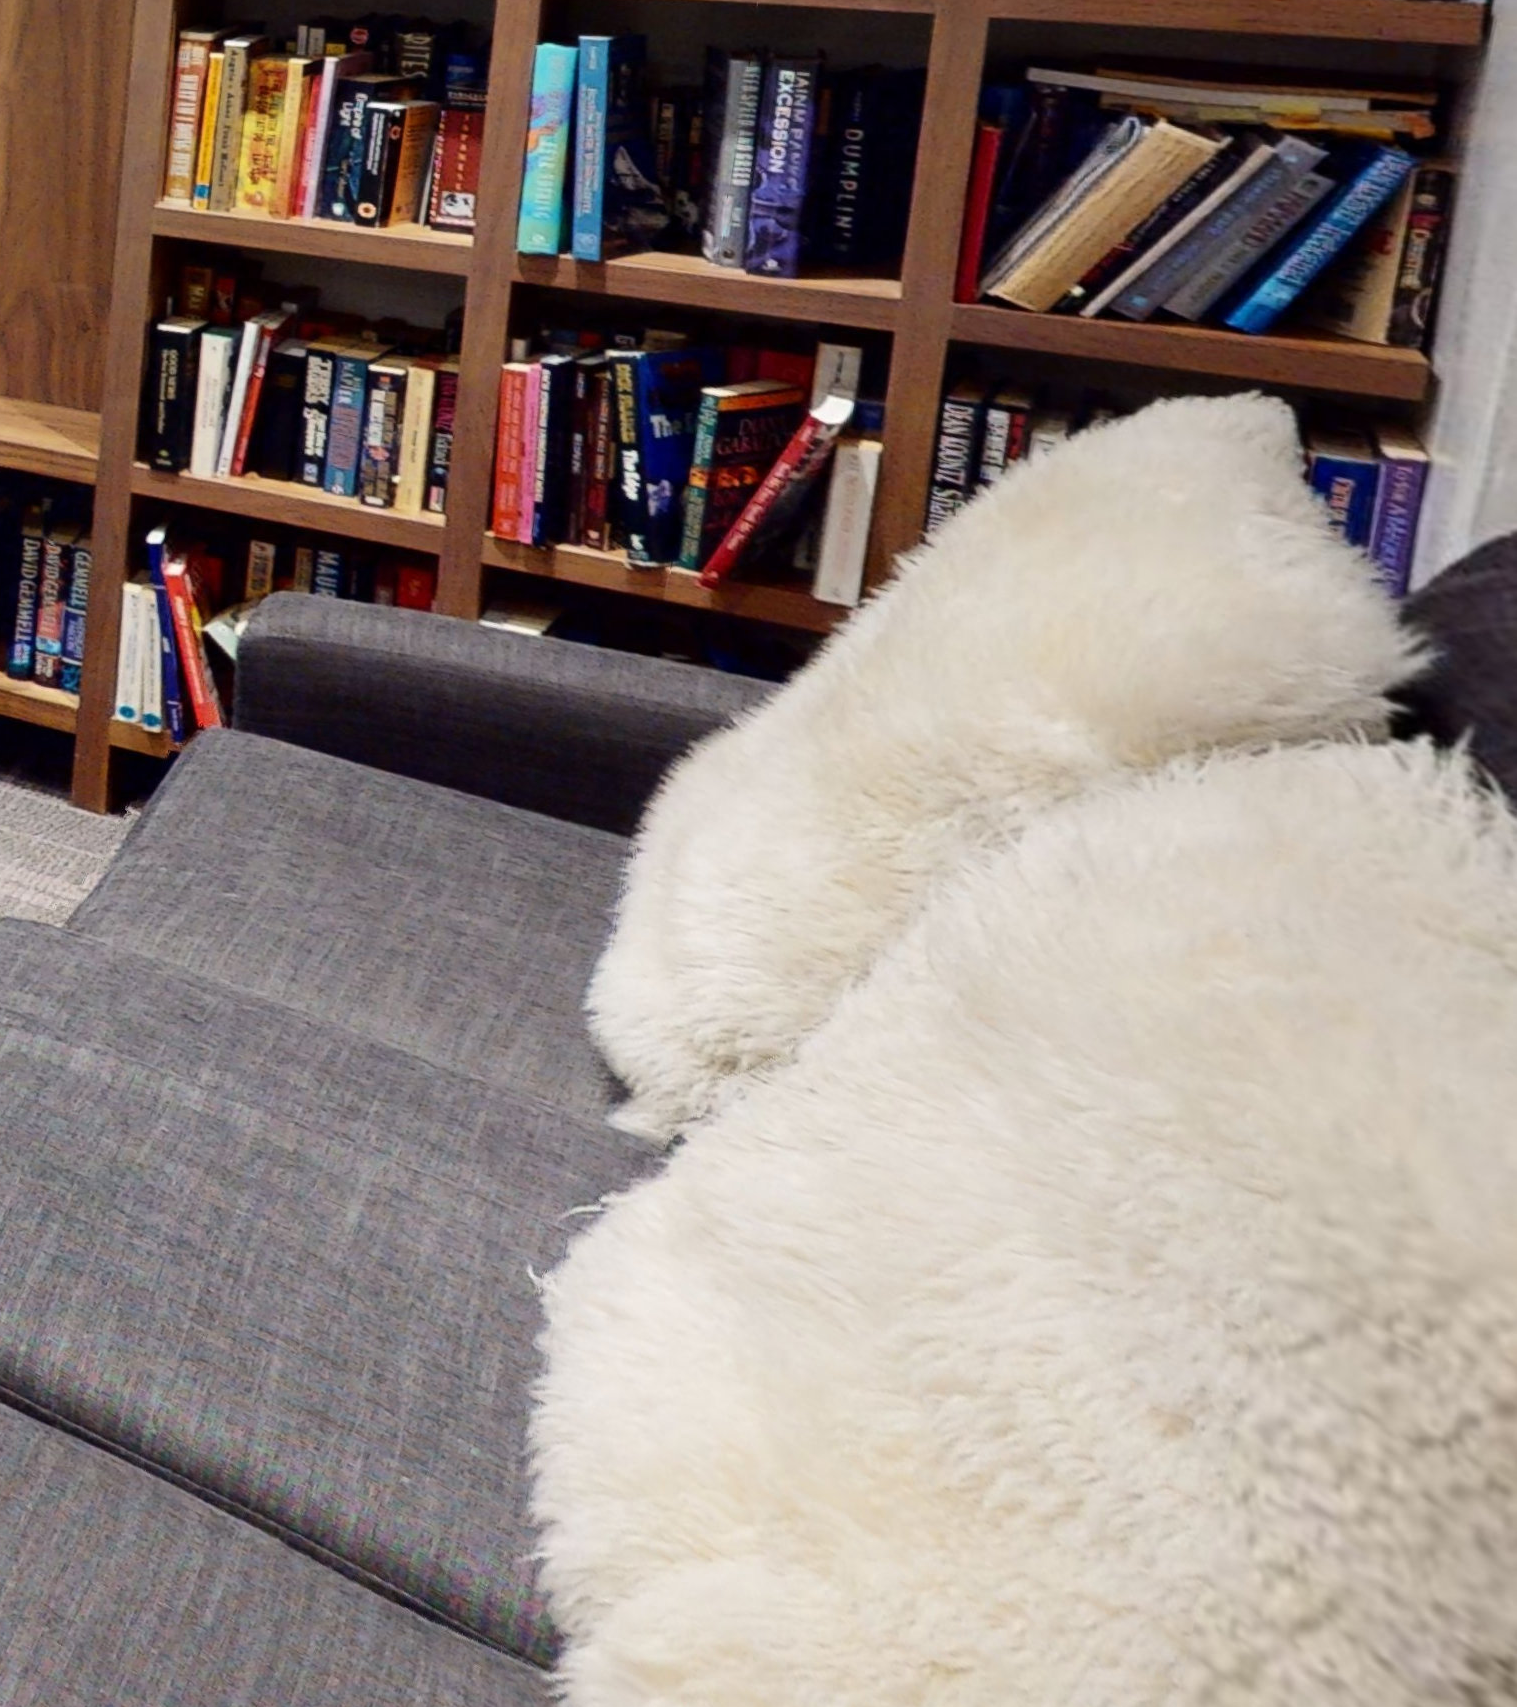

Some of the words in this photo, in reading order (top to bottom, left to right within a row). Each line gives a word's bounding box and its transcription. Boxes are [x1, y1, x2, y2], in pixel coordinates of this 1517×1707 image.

[792, 70, 811, 107] IAIN
[767, 68, 795, 174] EXCESSION
[730, 151, 752, 187] GREED
[938, 402, 976, 437] DEAN
[620, 448, 640, 471] The
[930, 432, 971, 486] KOONTZ
[620, 471, 642, 501] Edge
[18, 537, 41, 579] DAVID
[41, 540, 62, 578] DAVID
[68, 550, 90, 607] GEMMELL
[13, 579, 37, 643] GEMMELL
[38, 579, 59, 633] GEMMELL
